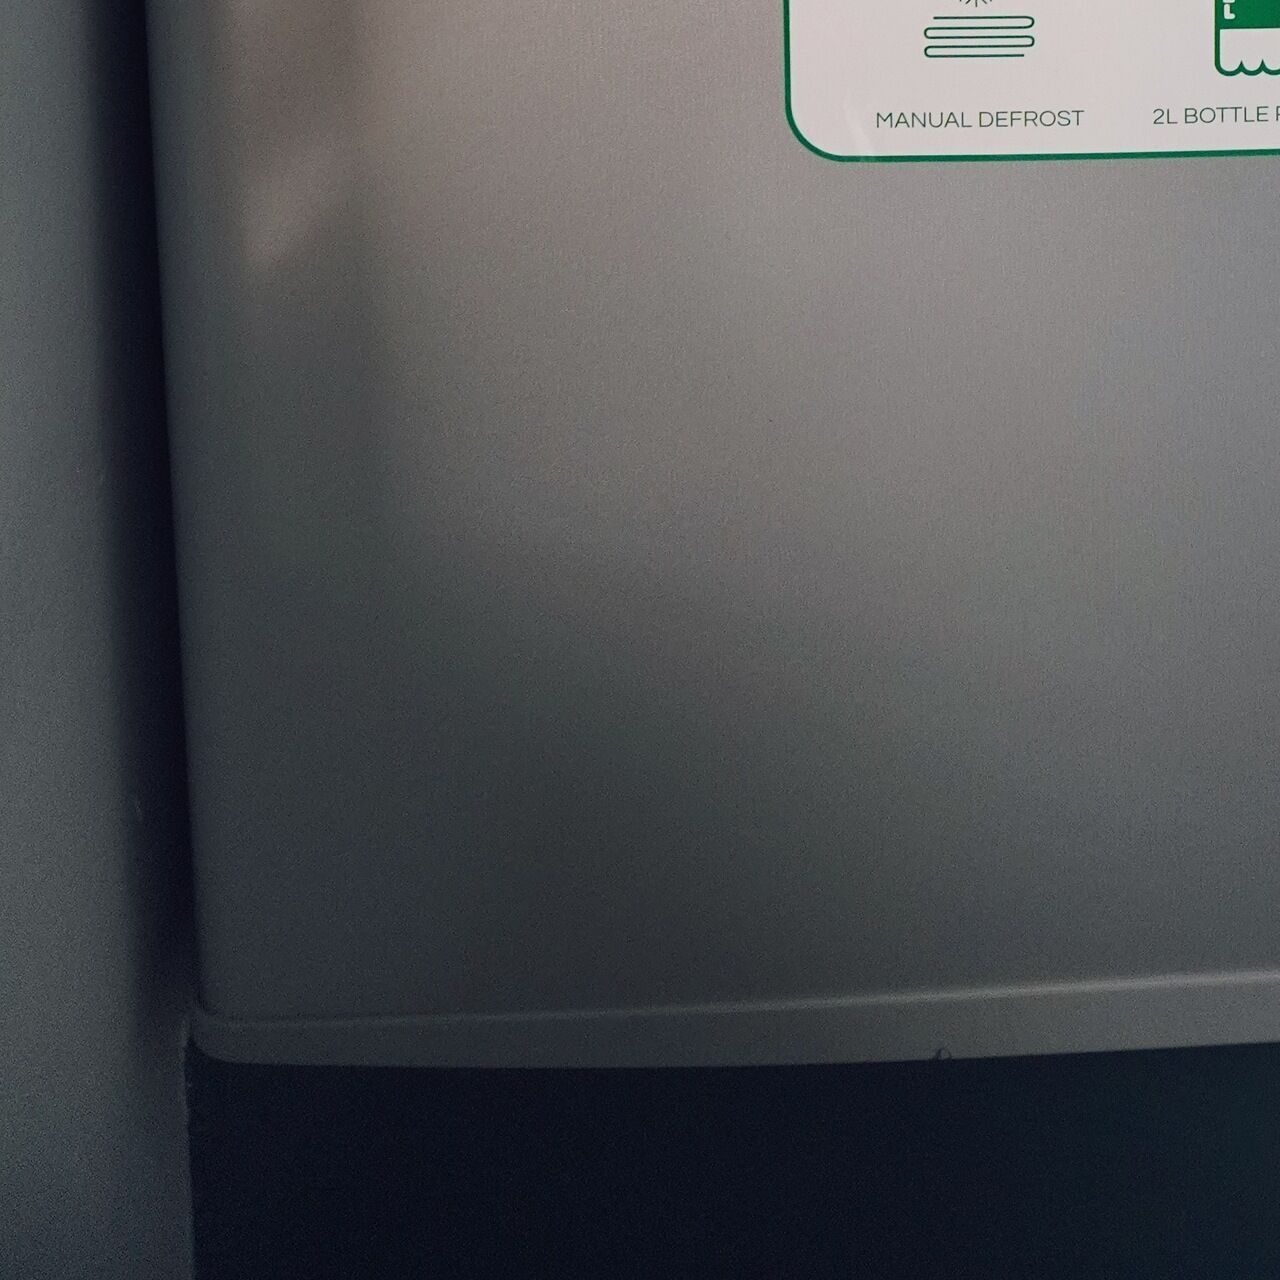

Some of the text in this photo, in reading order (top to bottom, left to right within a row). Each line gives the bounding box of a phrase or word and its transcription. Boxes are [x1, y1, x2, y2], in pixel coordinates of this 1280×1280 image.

[875, 109, 1085, 129] MANUAL DEFROST
[1152, 107, 1179, 126] 2L
[1183, 104, 1269, 125] BOTTLE
